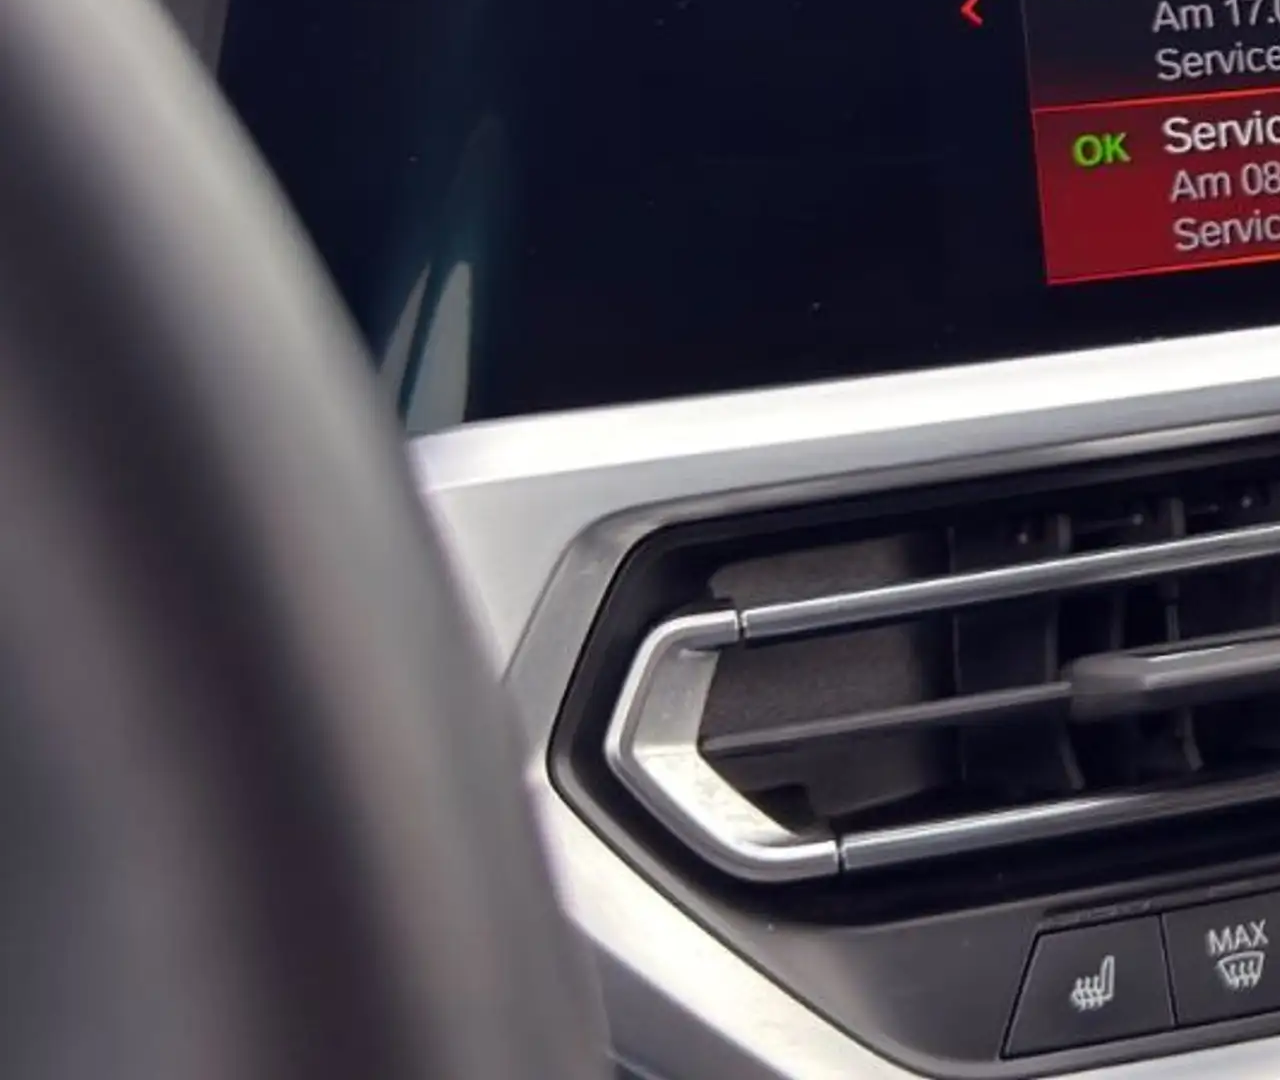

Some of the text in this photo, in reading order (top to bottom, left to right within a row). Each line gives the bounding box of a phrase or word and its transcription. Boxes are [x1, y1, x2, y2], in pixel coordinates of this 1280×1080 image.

[1152, 1, 1213, 32] Am
[1073, 134, 1130, 166] OK
[1170, 171, 1232, 203] Am
[1207, 920, 1269, 955] MAX
